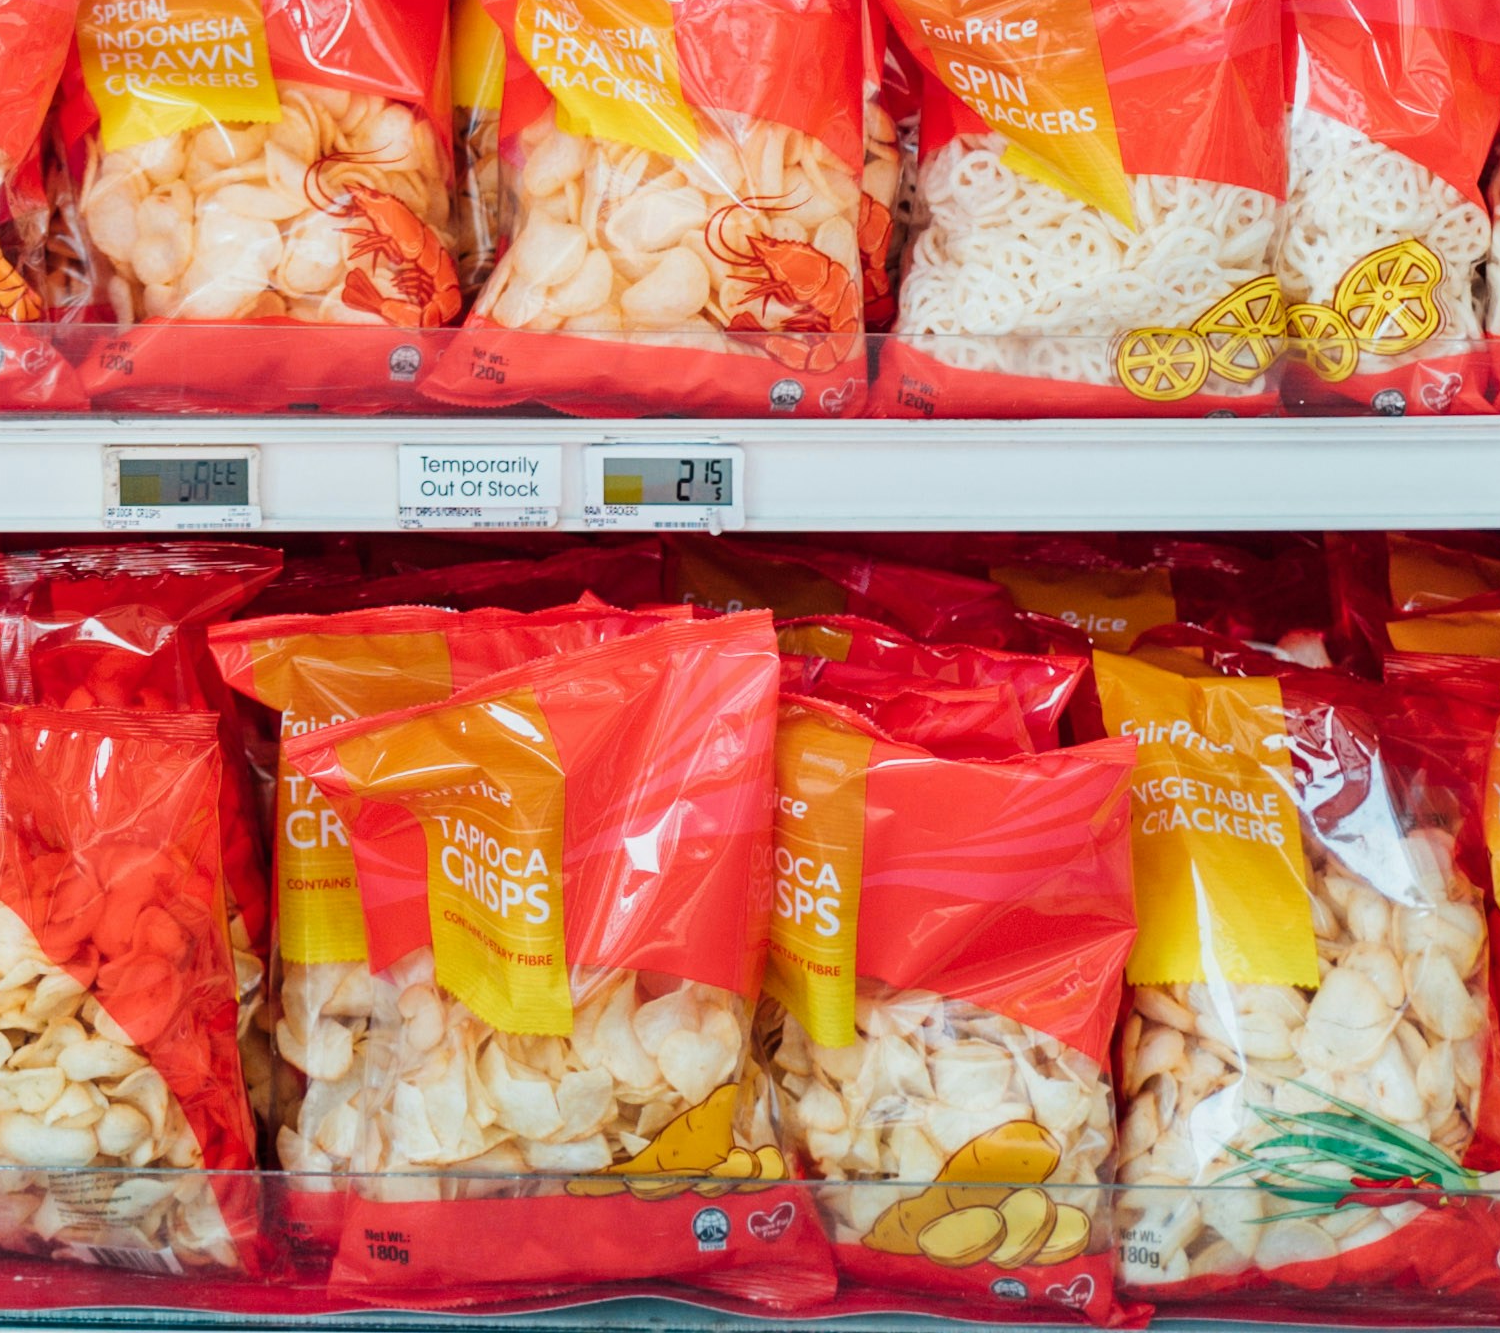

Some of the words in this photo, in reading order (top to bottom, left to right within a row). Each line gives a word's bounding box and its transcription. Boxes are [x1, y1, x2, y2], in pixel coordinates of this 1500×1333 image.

[96, 17, 249, 49] INDONESIA
[950, 60, 1029, 107] SPIN
[420, 457, 540, 478] Temporarily
[420, 481, 455, 499] Out
[460, 481, 483, 499] Of
[489, 481, 540, 499] Stock
[440, 845, 551, 924] CRISPS
[366, 1243, 410, 1266] 180g
